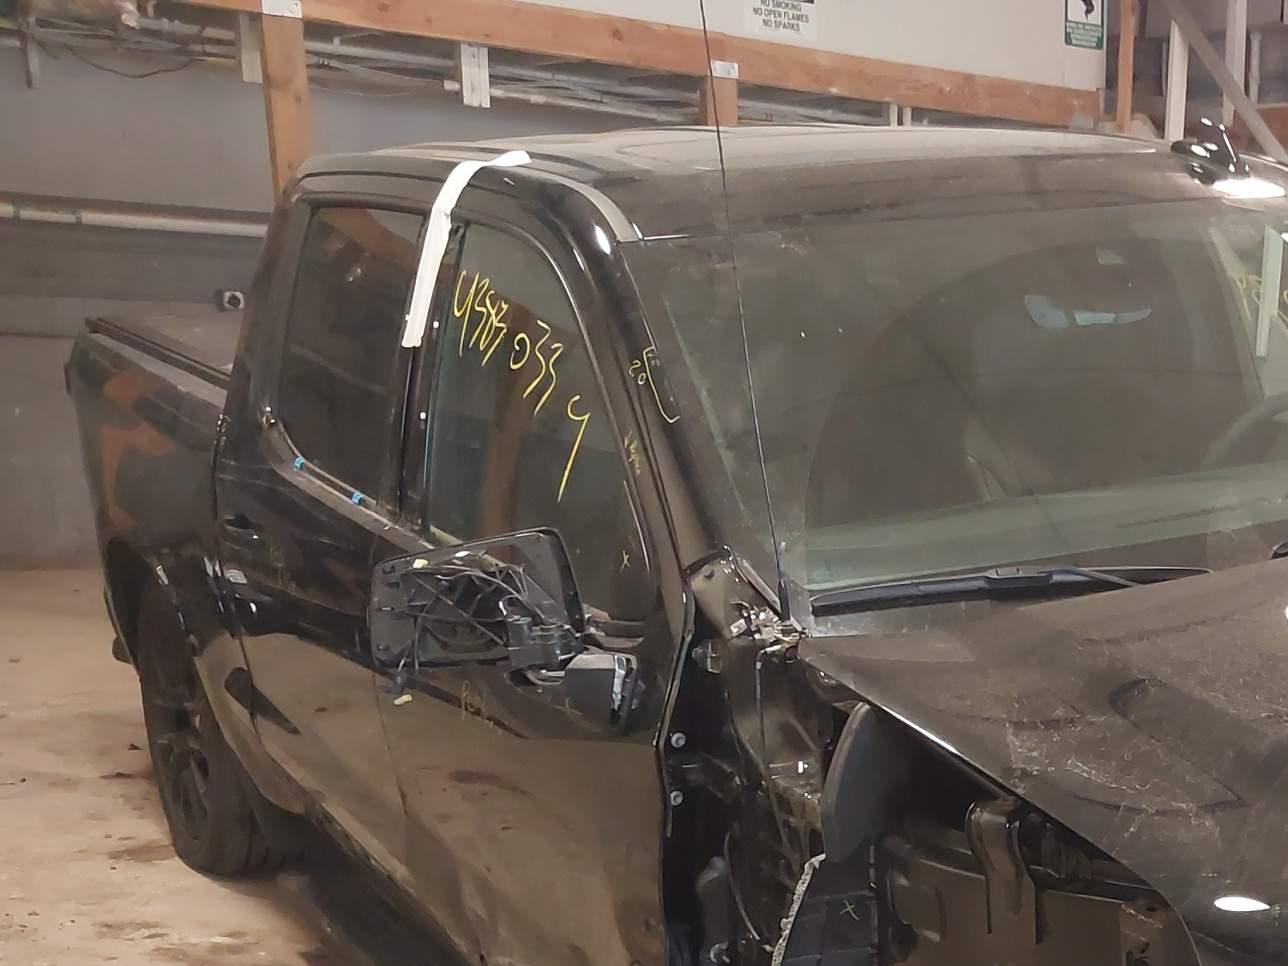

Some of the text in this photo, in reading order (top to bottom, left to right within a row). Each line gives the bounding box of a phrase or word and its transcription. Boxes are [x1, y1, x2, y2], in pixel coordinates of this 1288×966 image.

[760, 0, 802, 12] NO SMOKING
[752, 7, 810, 24] NO OPEN FLAMES
[762, 18, 800, 32] NO SPARKS
